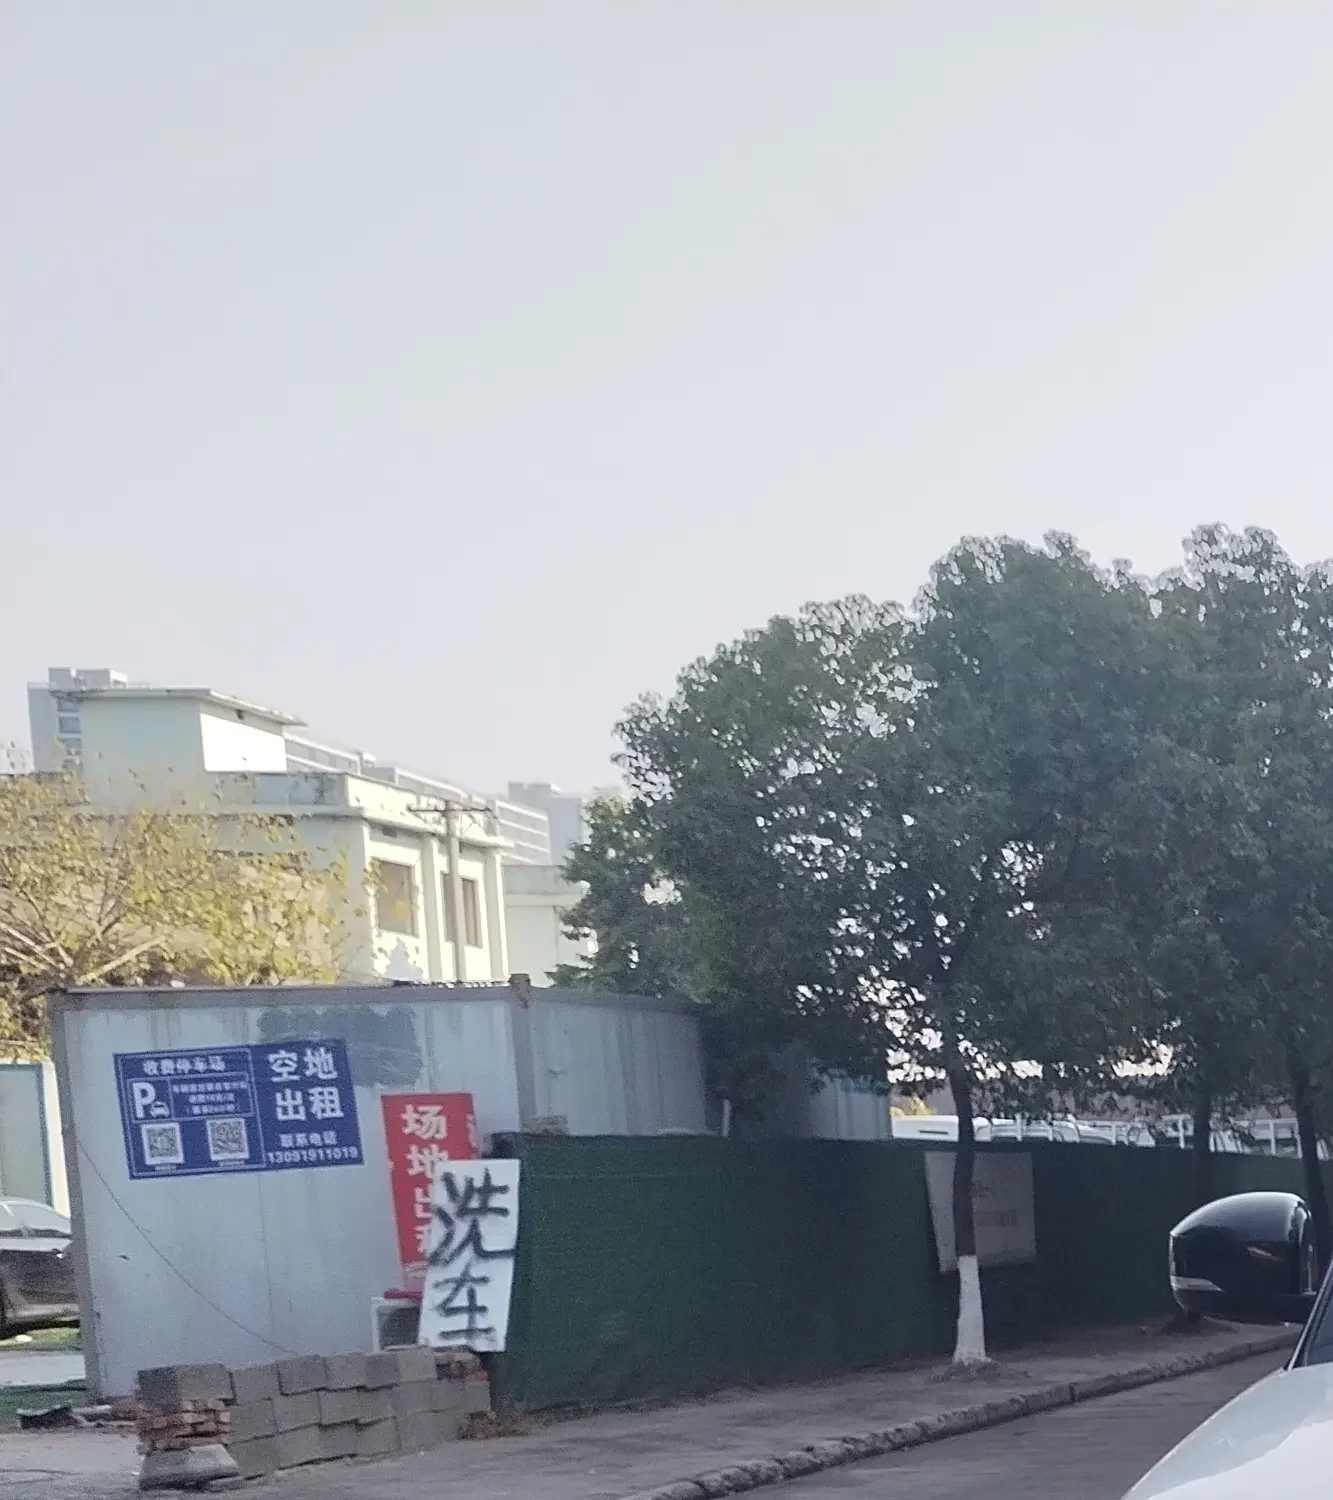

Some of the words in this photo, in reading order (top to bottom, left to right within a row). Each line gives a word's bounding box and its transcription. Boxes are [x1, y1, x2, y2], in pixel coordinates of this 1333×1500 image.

[267, 1046, 338, 1082] 空地
[275, 1086, 344, 1121] 出租
[429, 1167, 516, 1341] 洗车
